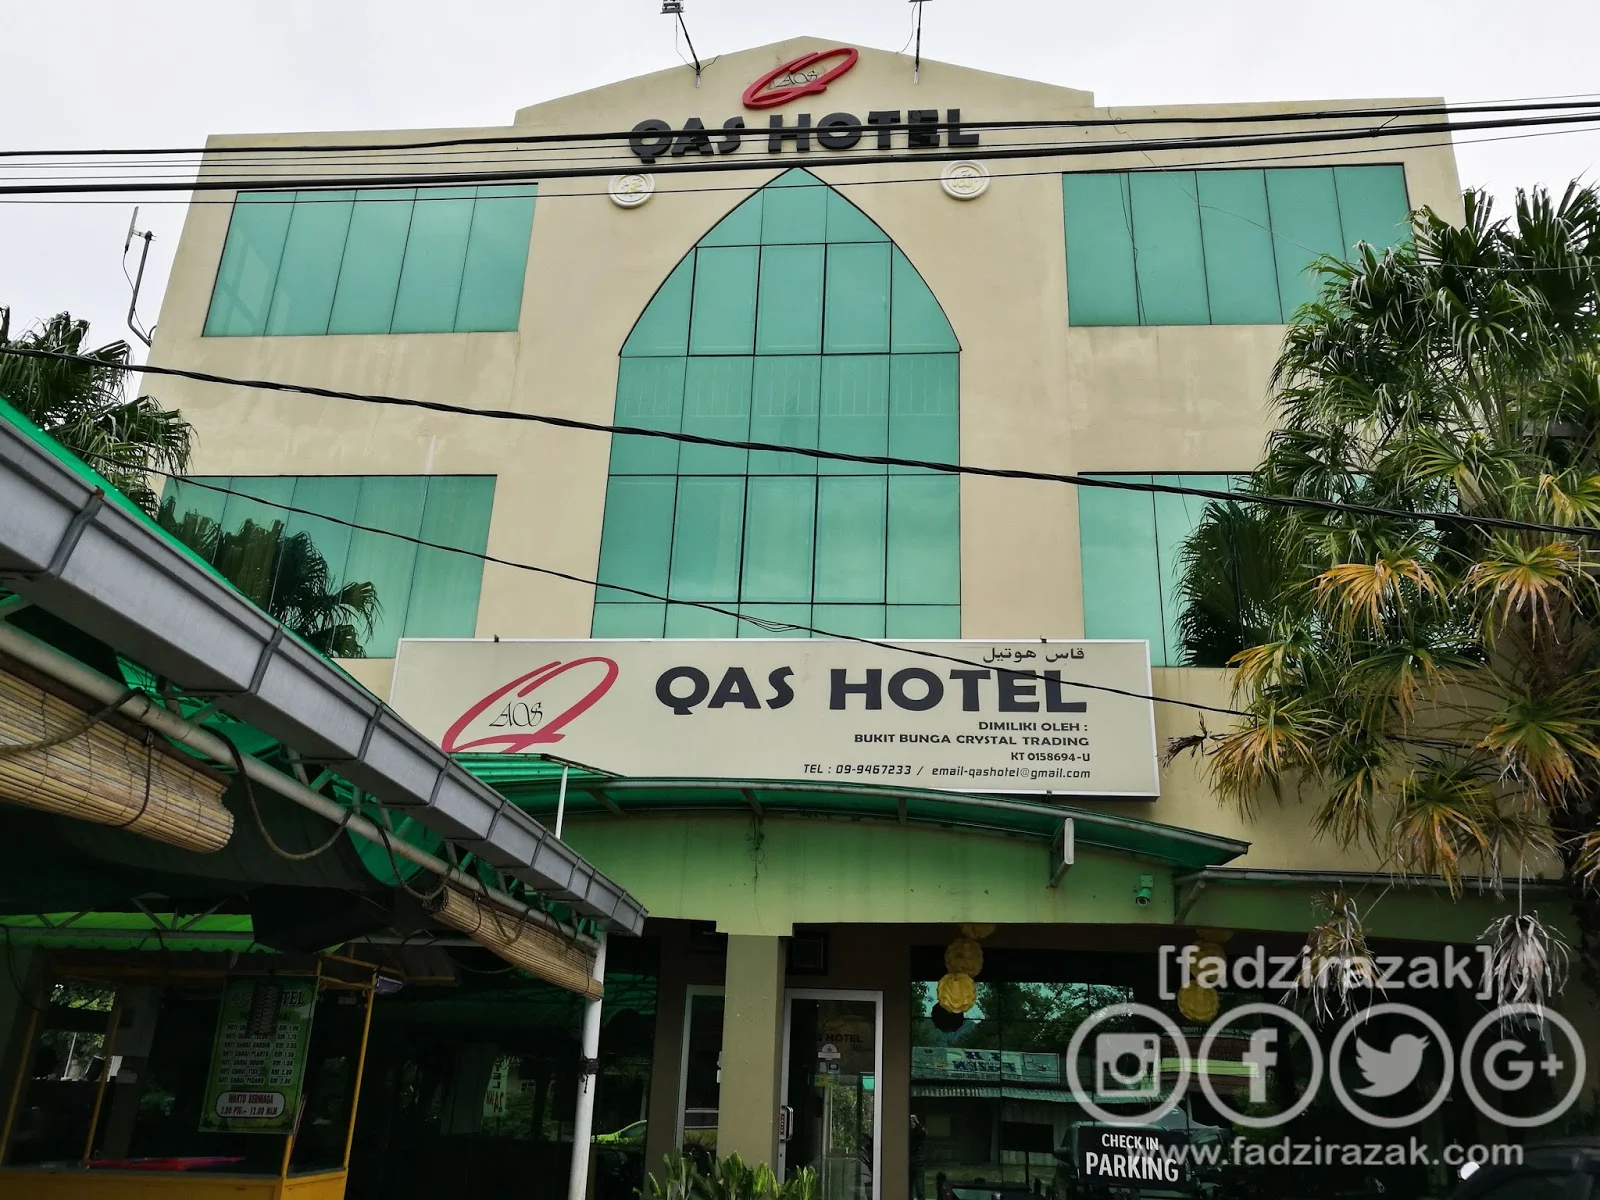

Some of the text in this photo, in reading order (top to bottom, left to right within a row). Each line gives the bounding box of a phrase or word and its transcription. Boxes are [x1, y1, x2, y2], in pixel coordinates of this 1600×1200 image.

[628, 108, 980, 163] QAS HOTEL
[983, 647, 1085, 663] قاس هوتيل
[655, 666, 1088, 715] QAS HOTEL
[978, 721, 1037, 731] DIMILIKI
[854, 734, 1090, 747] BUKIT BUNGA CRYSTAL TRADING
[1010, 752, 1025, 761] KT
[803, 764, 824, 774] TEL
[836, 764, 912, 775] 09-9467233
[932, 764, 1091, 780] email-qashotel@gmail.com
[1101, 1133, 1159, 1150] CHECK IN
[1085, 1151, 1179, 1182] PARKING
